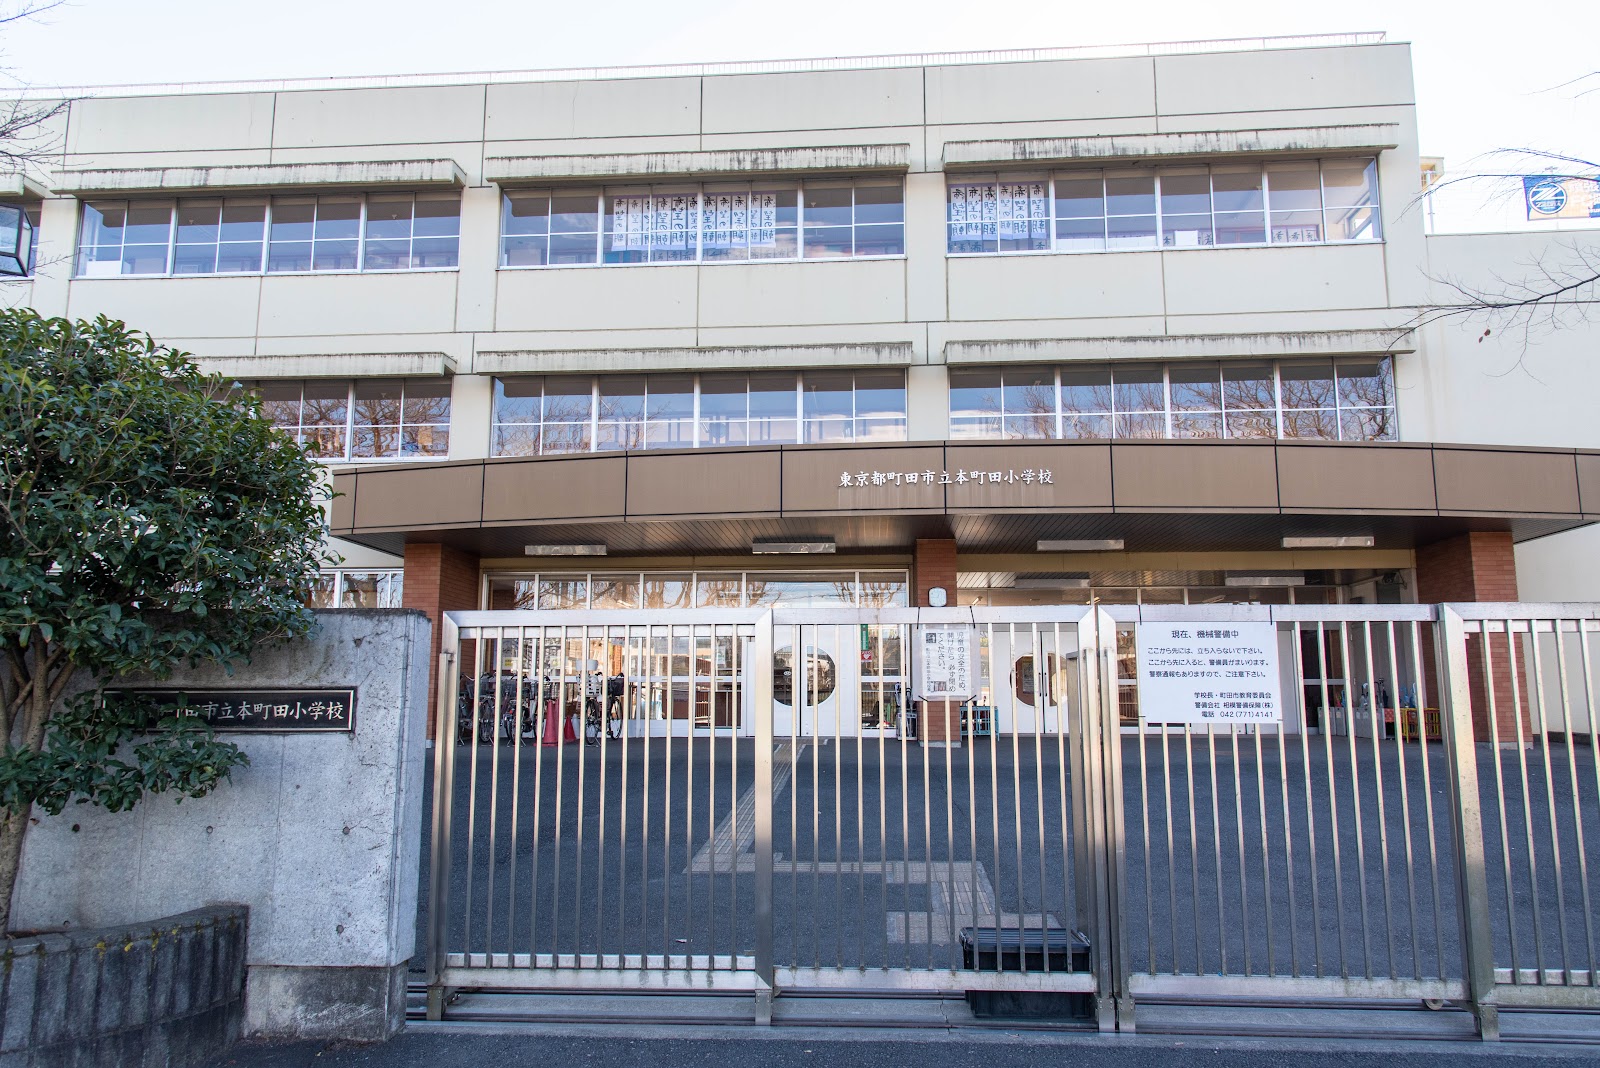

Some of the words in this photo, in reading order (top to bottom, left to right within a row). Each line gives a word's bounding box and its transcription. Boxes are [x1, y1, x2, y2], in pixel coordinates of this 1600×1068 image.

[838, 469, 1053, 487] 東京都町田市立本町田小学校
[1171, 630, 1239, 639] 現在、機械警備中
[1147, 647, 1263, 655] ここから先には、立ち入らないで下さい。
